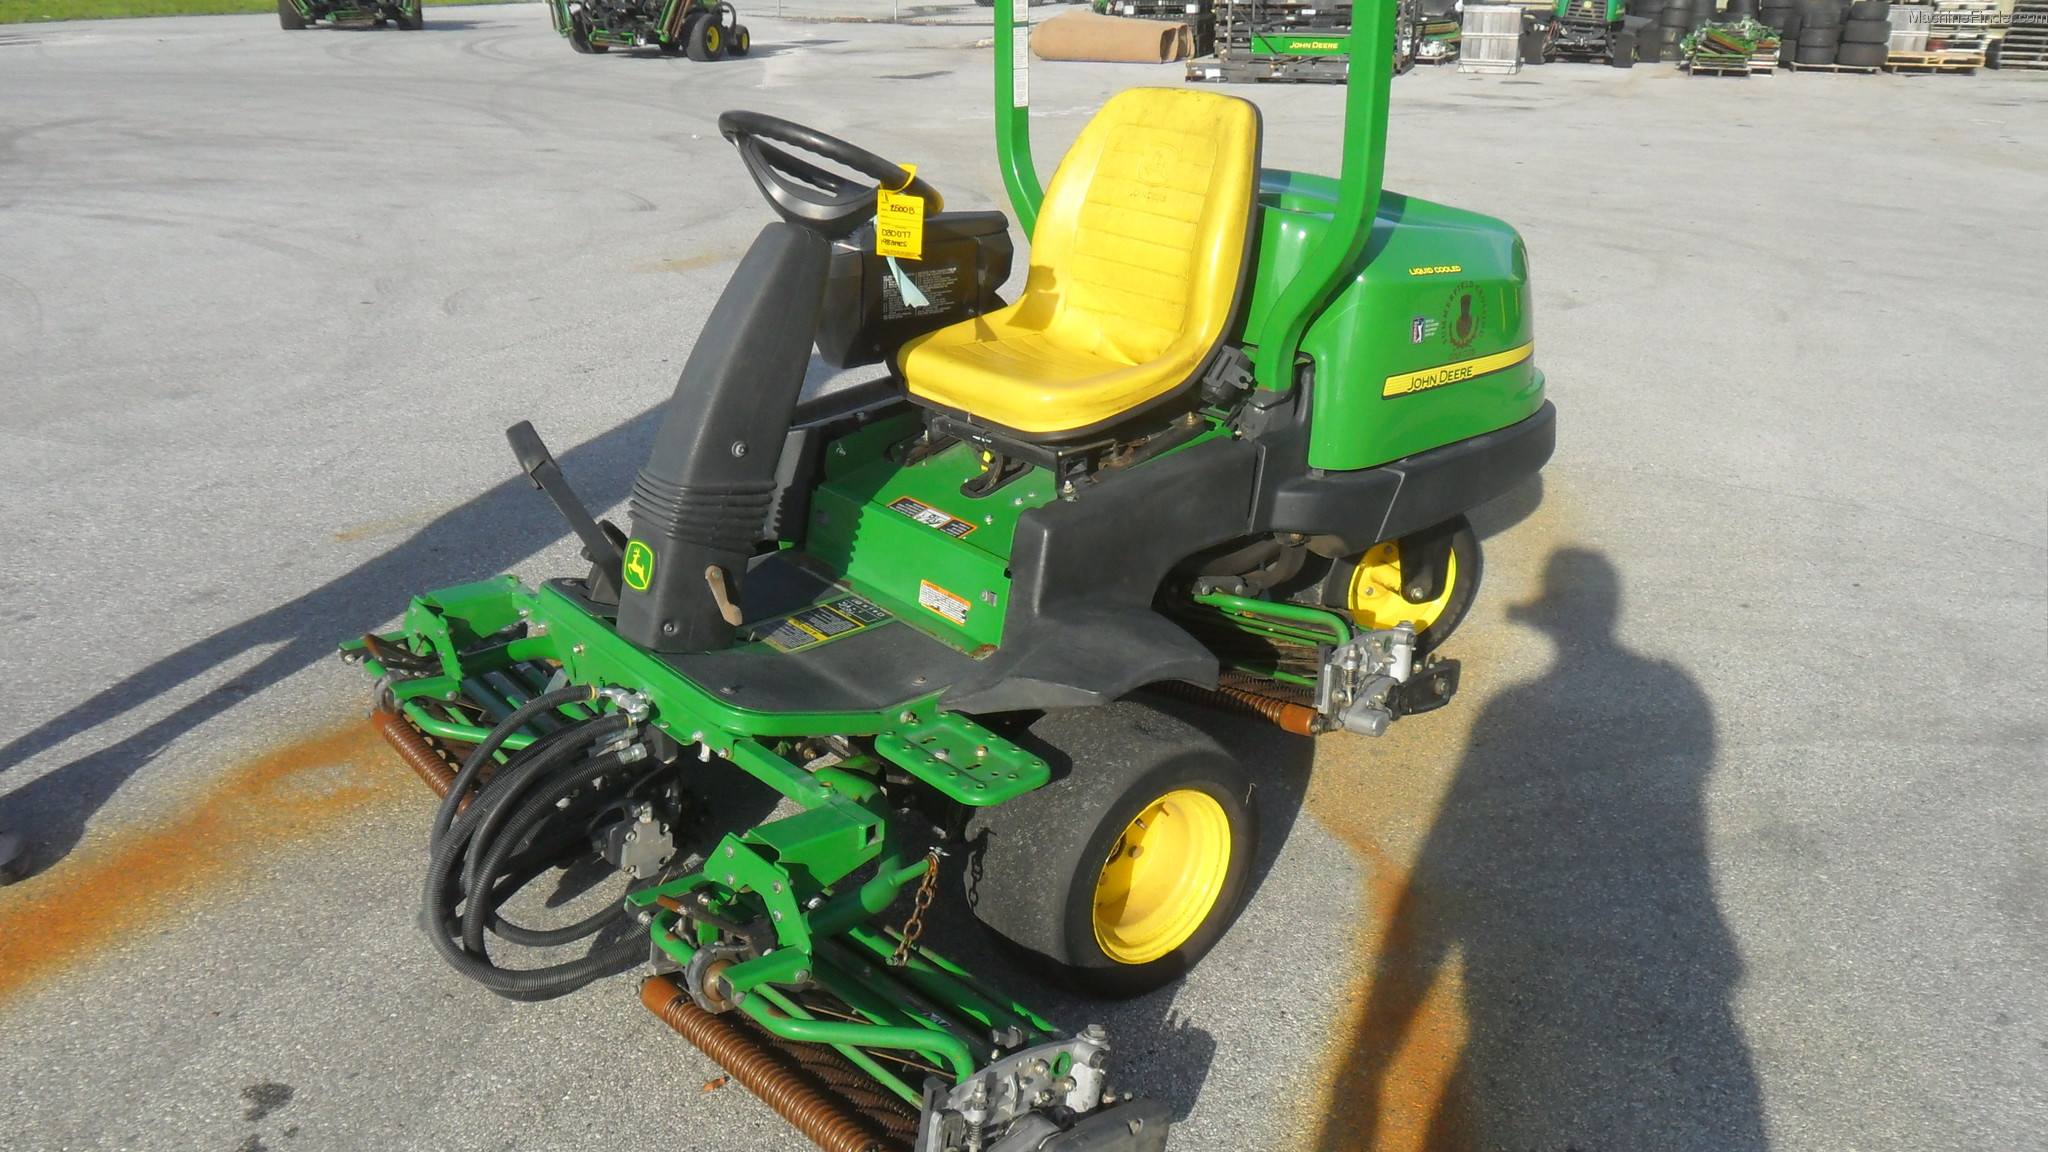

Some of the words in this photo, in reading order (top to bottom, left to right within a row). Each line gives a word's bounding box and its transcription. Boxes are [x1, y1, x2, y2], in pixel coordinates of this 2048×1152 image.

[1289, 41, 1311, 49] JOHN
[1312, 41, 1338, 49] DEERE
[1409, 267, 1434, 276] LIQUID
[1433, 265, 1462, 274] COOLED
[1407, 375, 1438, 392] JOHN
[1438, 366, 1474, 385] DEERE
